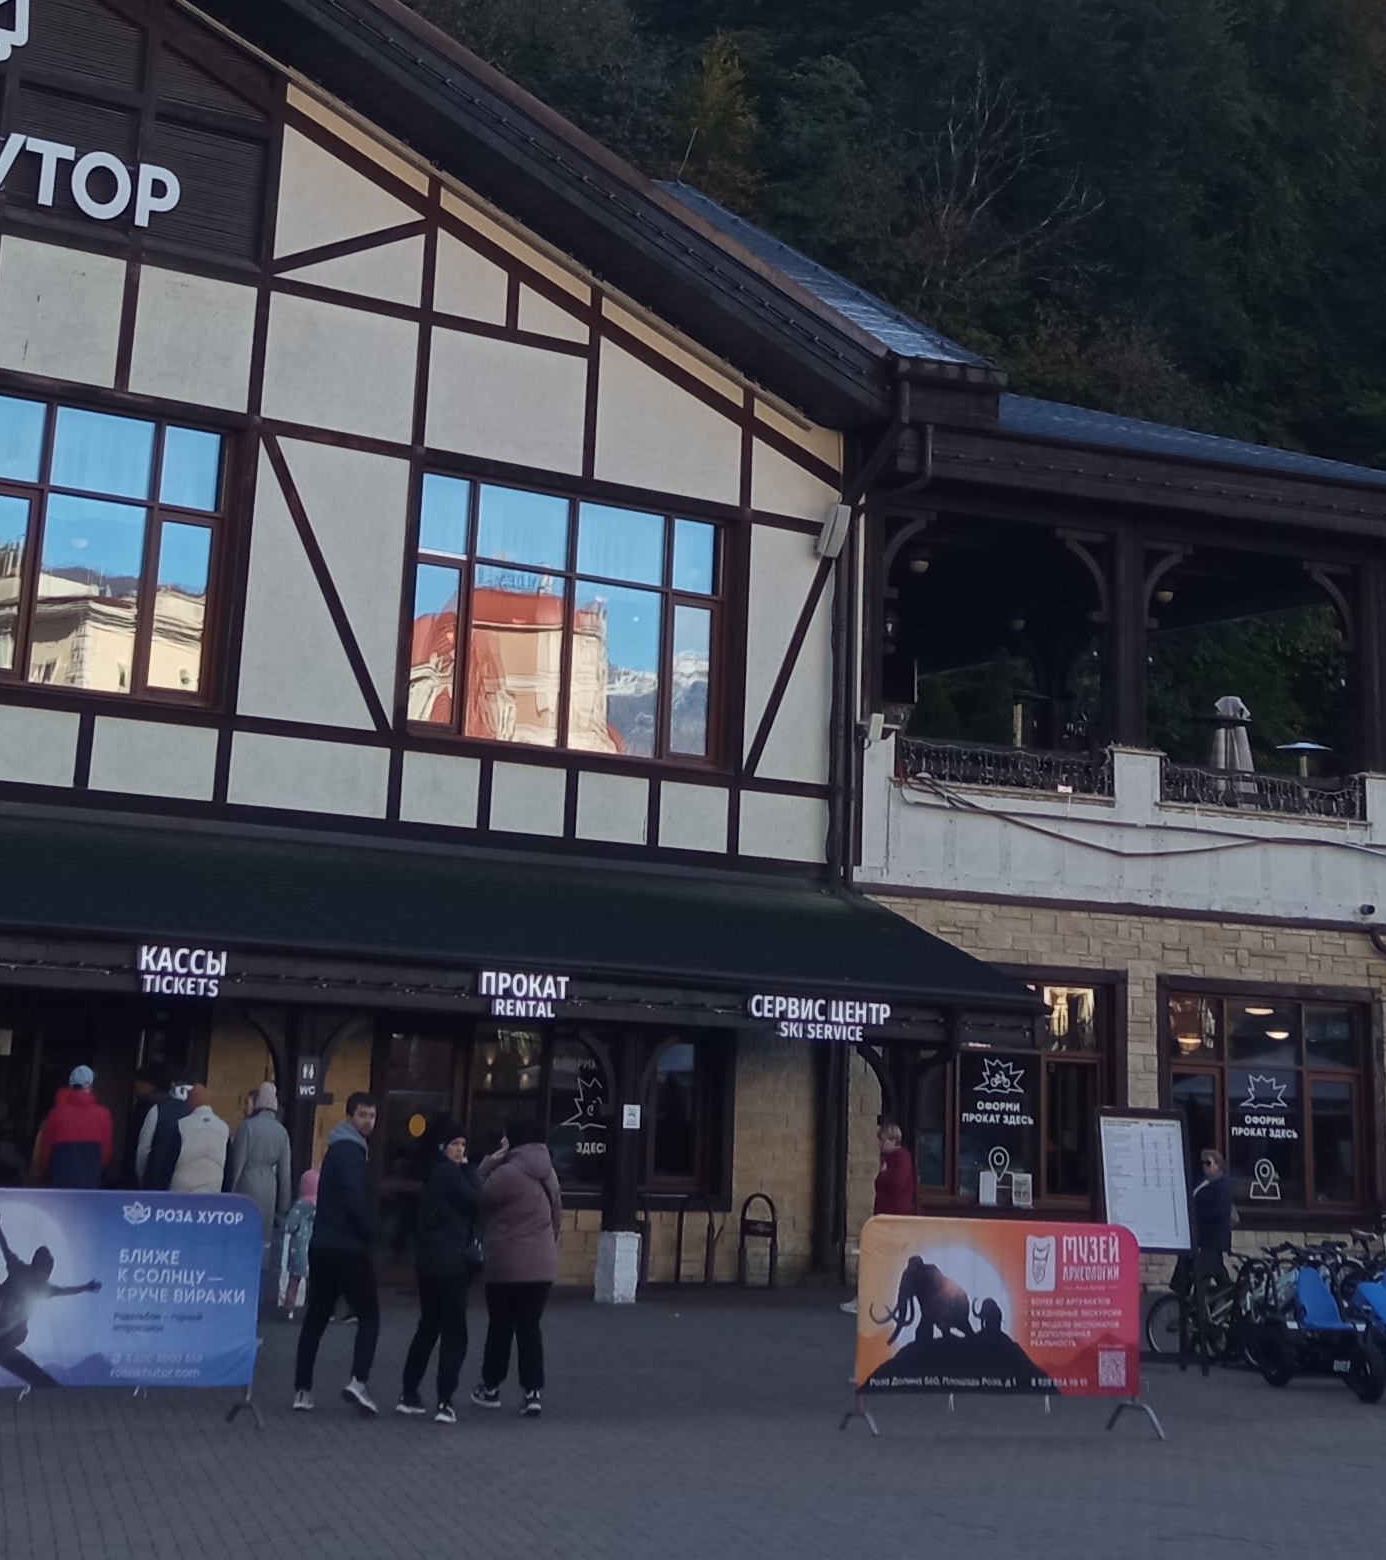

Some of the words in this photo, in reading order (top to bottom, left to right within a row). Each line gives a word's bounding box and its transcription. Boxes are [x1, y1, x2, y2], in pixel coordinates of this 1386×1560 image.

[139, 945, 228, 976] КАССЫ
[143, 974, 219, 998] TICKETS
[481, 971, 570, 1000] ПРОКАТ
[494, 999, 556, 1018] RENTAL
[751, 994, 826, 1021] СЕРВИС
[830, 1000, 891, 1026] ЦЕНТР
[779, 1021, 803, 1038] SKI
[807, 1023, 864, 1042] SERVICE
[299, 1085, 316, 1096] WC
[976, 1101, 1020, 1113] ОФОРМИ
[962, 1113, 1001, 1124] ПРОКАТ
[1002, 1115, 1035, 1126] ЗДЕСЬ
[1244, 1114, 1286, 1126] ОФОРМИ
[1231, 1126, 1268, 1137] ПРОКАТ
[1268, 1128, 1299, 1139] ЗДЕСЬ
[155, 1209, 193, 1223] РОЗА
[196, 1210, 244, 1225] ХУТОР
[119, 1248, 181, 1265] БЛИЖЕ
[1062, 1232, 1119, 1264] МУЗЕЙ
[117, 1268, 128, 1283] К
[134, 1269, 206, 1287] СОЛНЦУ
[1062, 1265, 1120, 1282] АРХЕОЛОГИИ
[116, 1287, 168, 1303] КРУЧЕ
[174, 1288, 246, 1305] ВИРАЖИ
[1066, 1298, 1111, 1306] АРТЕФАКТОВ
